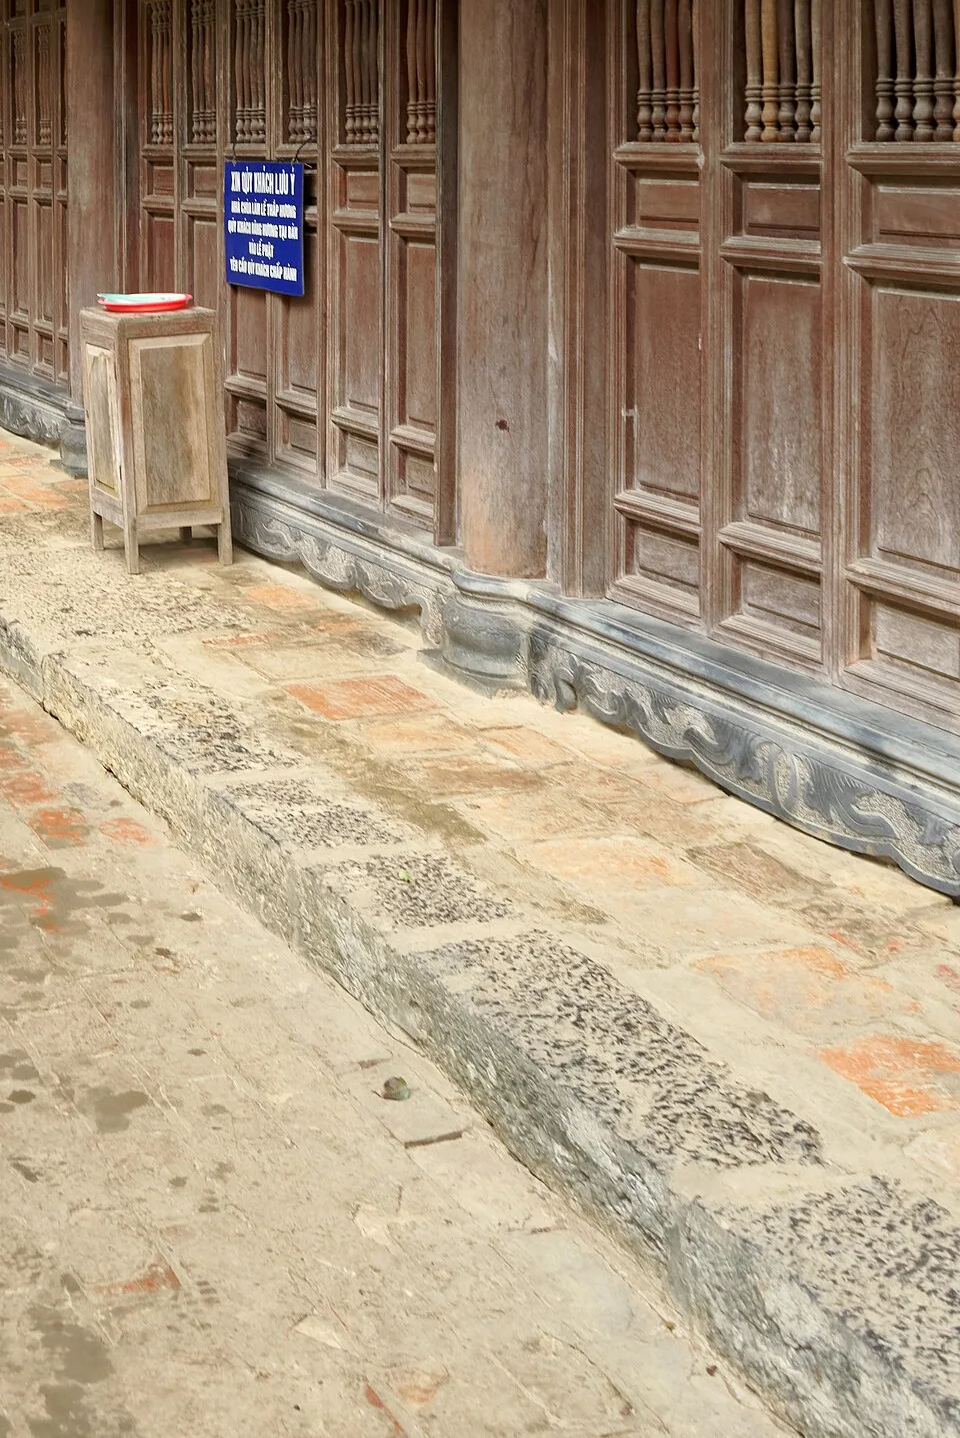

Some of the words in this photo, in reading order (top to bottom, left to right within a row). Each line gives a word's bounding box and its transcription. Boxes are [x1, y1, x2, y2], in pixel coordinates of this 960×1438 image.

[231, 171, 240, 192] XIN
[242, 166, 252, 194] QUÝ
[254, 165, 274, 194] KHÁCH
[275, 169, 289, 195] LƯU
[290, 166, 295, 195] Ý
[261, 198, 267, 216] LỄ
[267, 199, 279, 217] THẮP
[228, 217, 236, 234] QUÝ
[237, 218, 251, 234] KHÁCH
[279, 224, 287, 241] TẠI
[257, 238, 262, 256] LỄ
[262, 242, 274, 260] PHẬT
[239, 256, 247, 273] CẦU
[255, 260, 269, 277] KHÁCH
